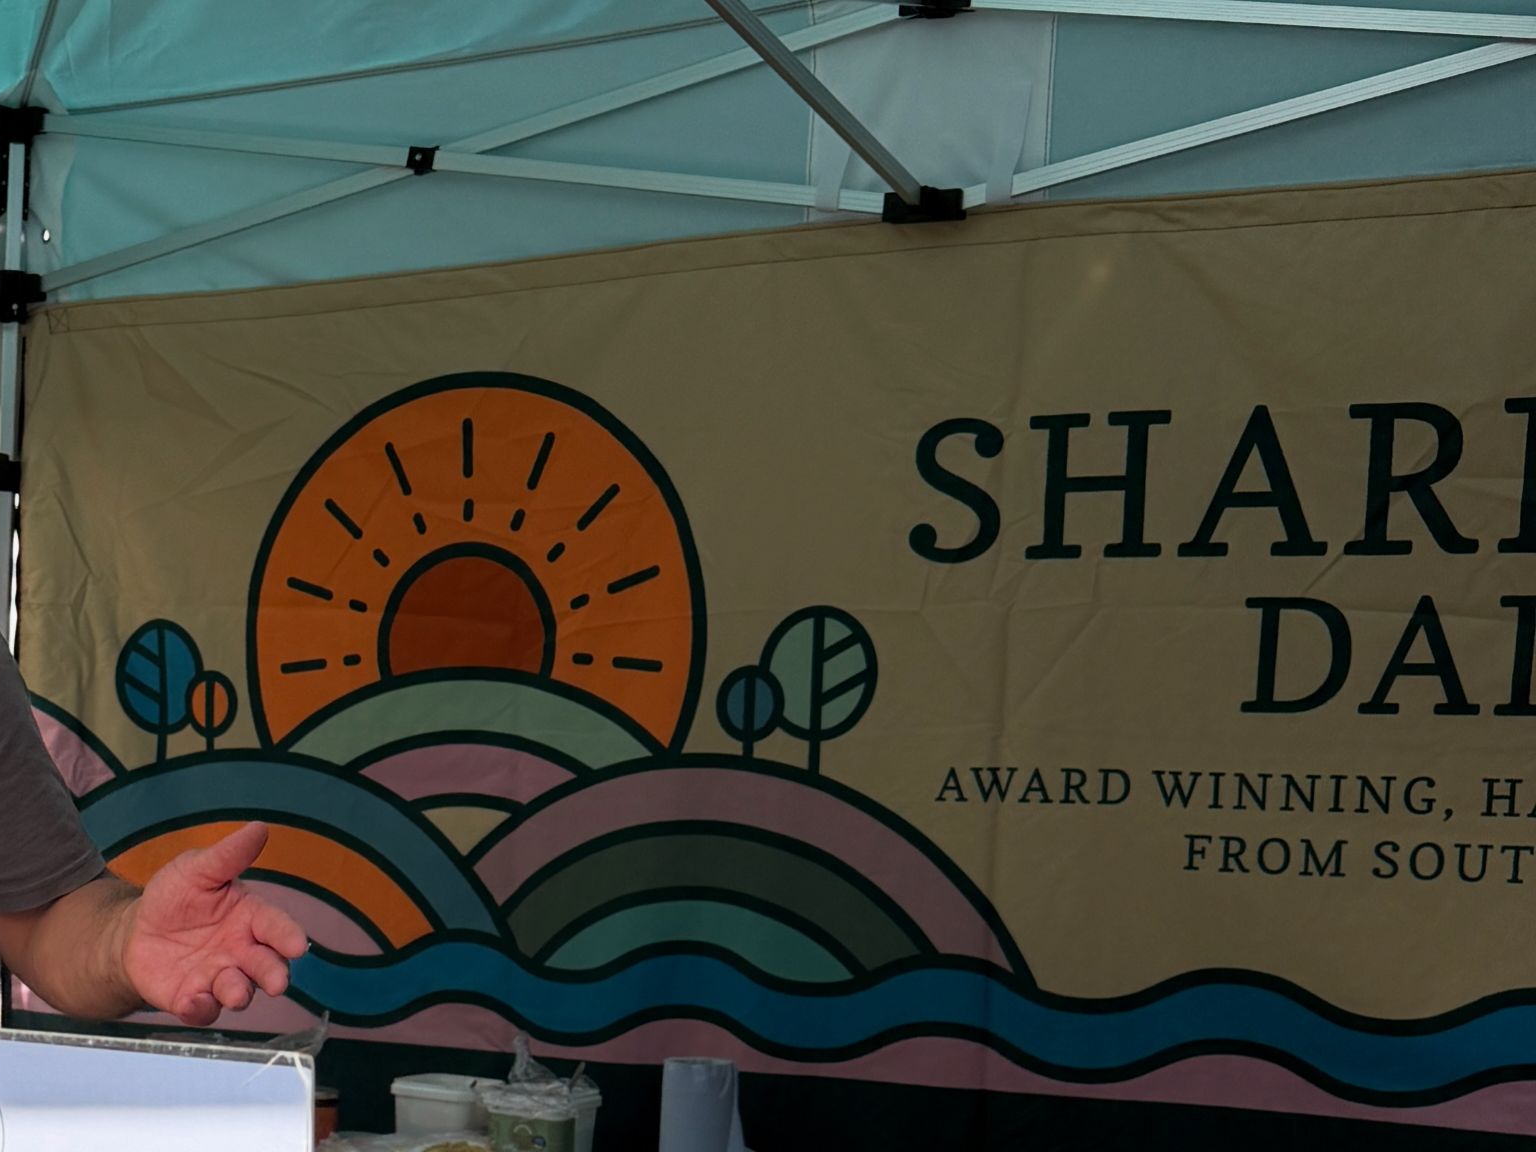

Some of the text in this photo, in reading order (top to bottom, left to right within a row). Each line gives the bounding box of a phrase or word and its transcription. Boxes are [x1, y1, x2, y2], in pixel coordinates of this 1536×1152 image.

[935, 767, 1454, 822] AWARD WINNING,
[1183, 834, 1348, 877] FROM
